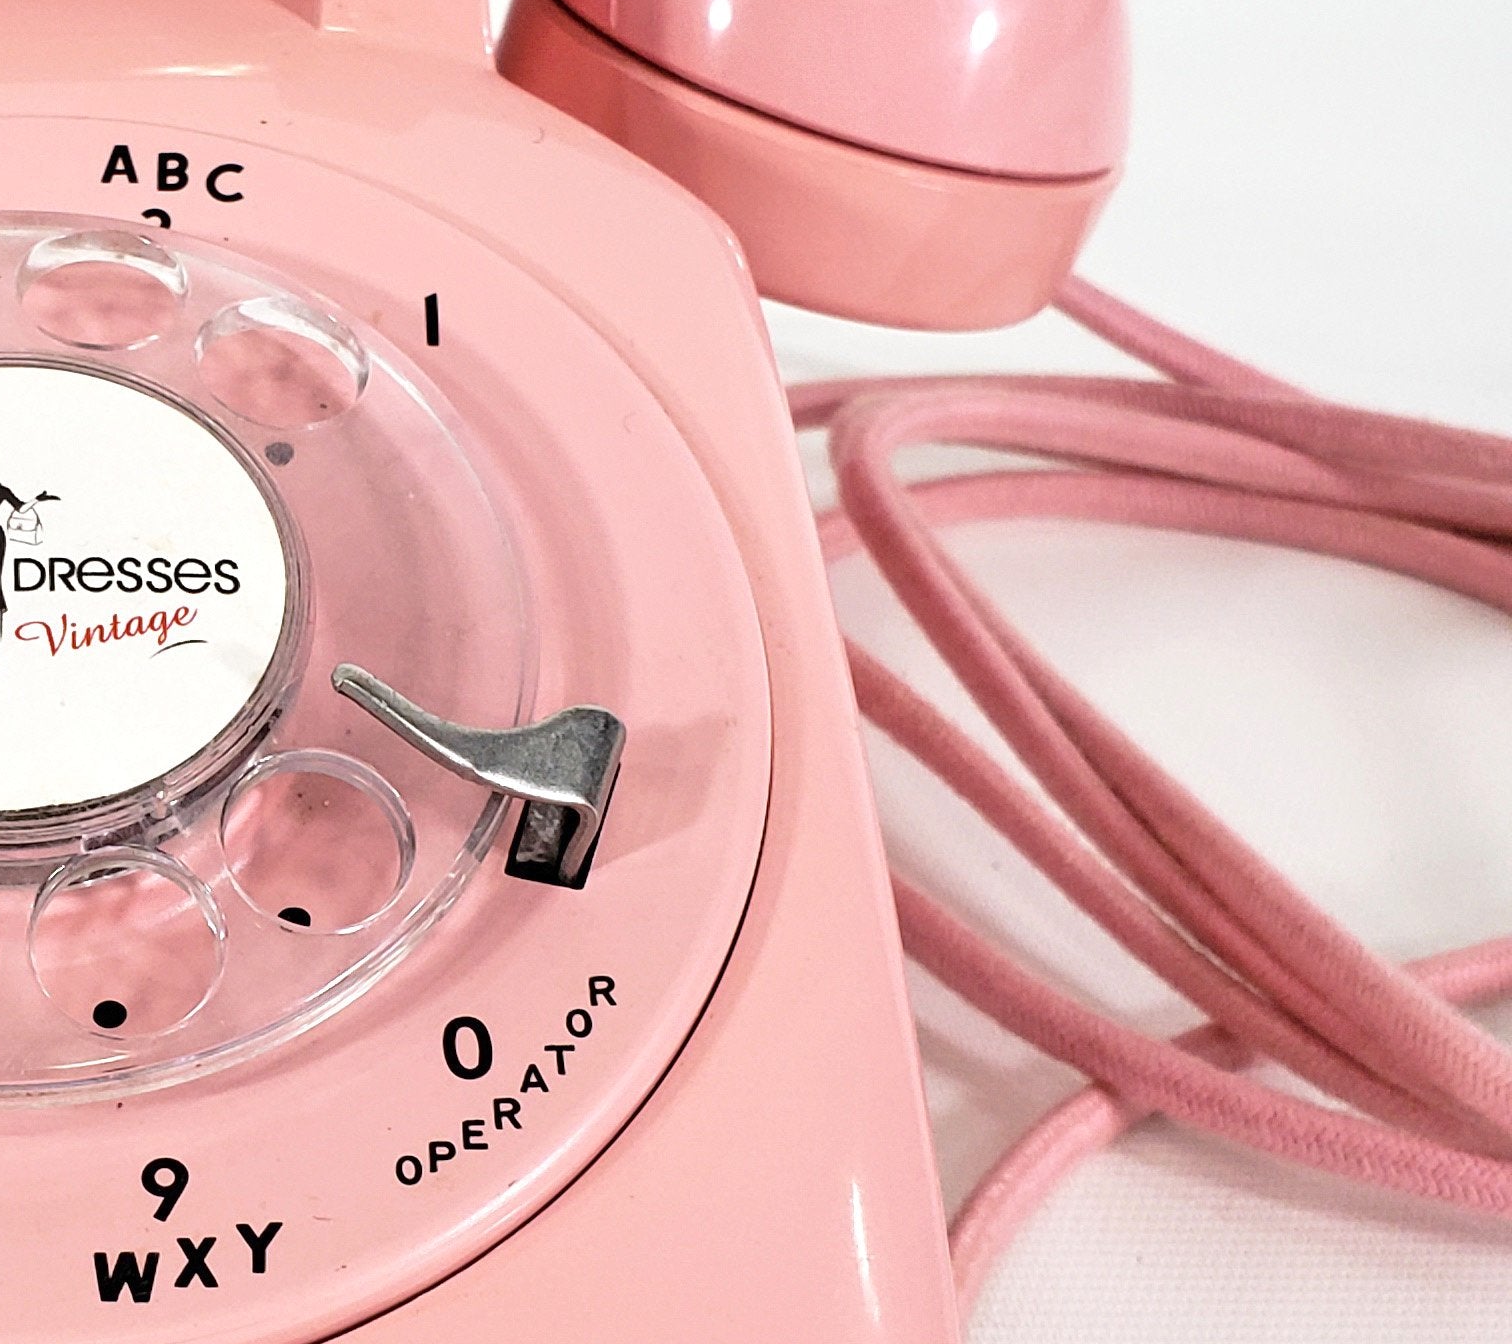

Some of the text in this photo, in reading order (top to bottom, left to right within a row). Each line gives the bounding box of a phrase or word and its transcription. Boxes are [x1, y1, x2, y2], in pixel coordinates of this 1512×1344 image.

[101, 144, 245, 203] ABC
[424, 293, 440, 347] 1
[14, 605, 198, 657] Vintage
[395, 975, 618, 1186] OPERATOR
[141, 1157, 189, 1222] 9
[93, 1221, 283, 1303] WXY
